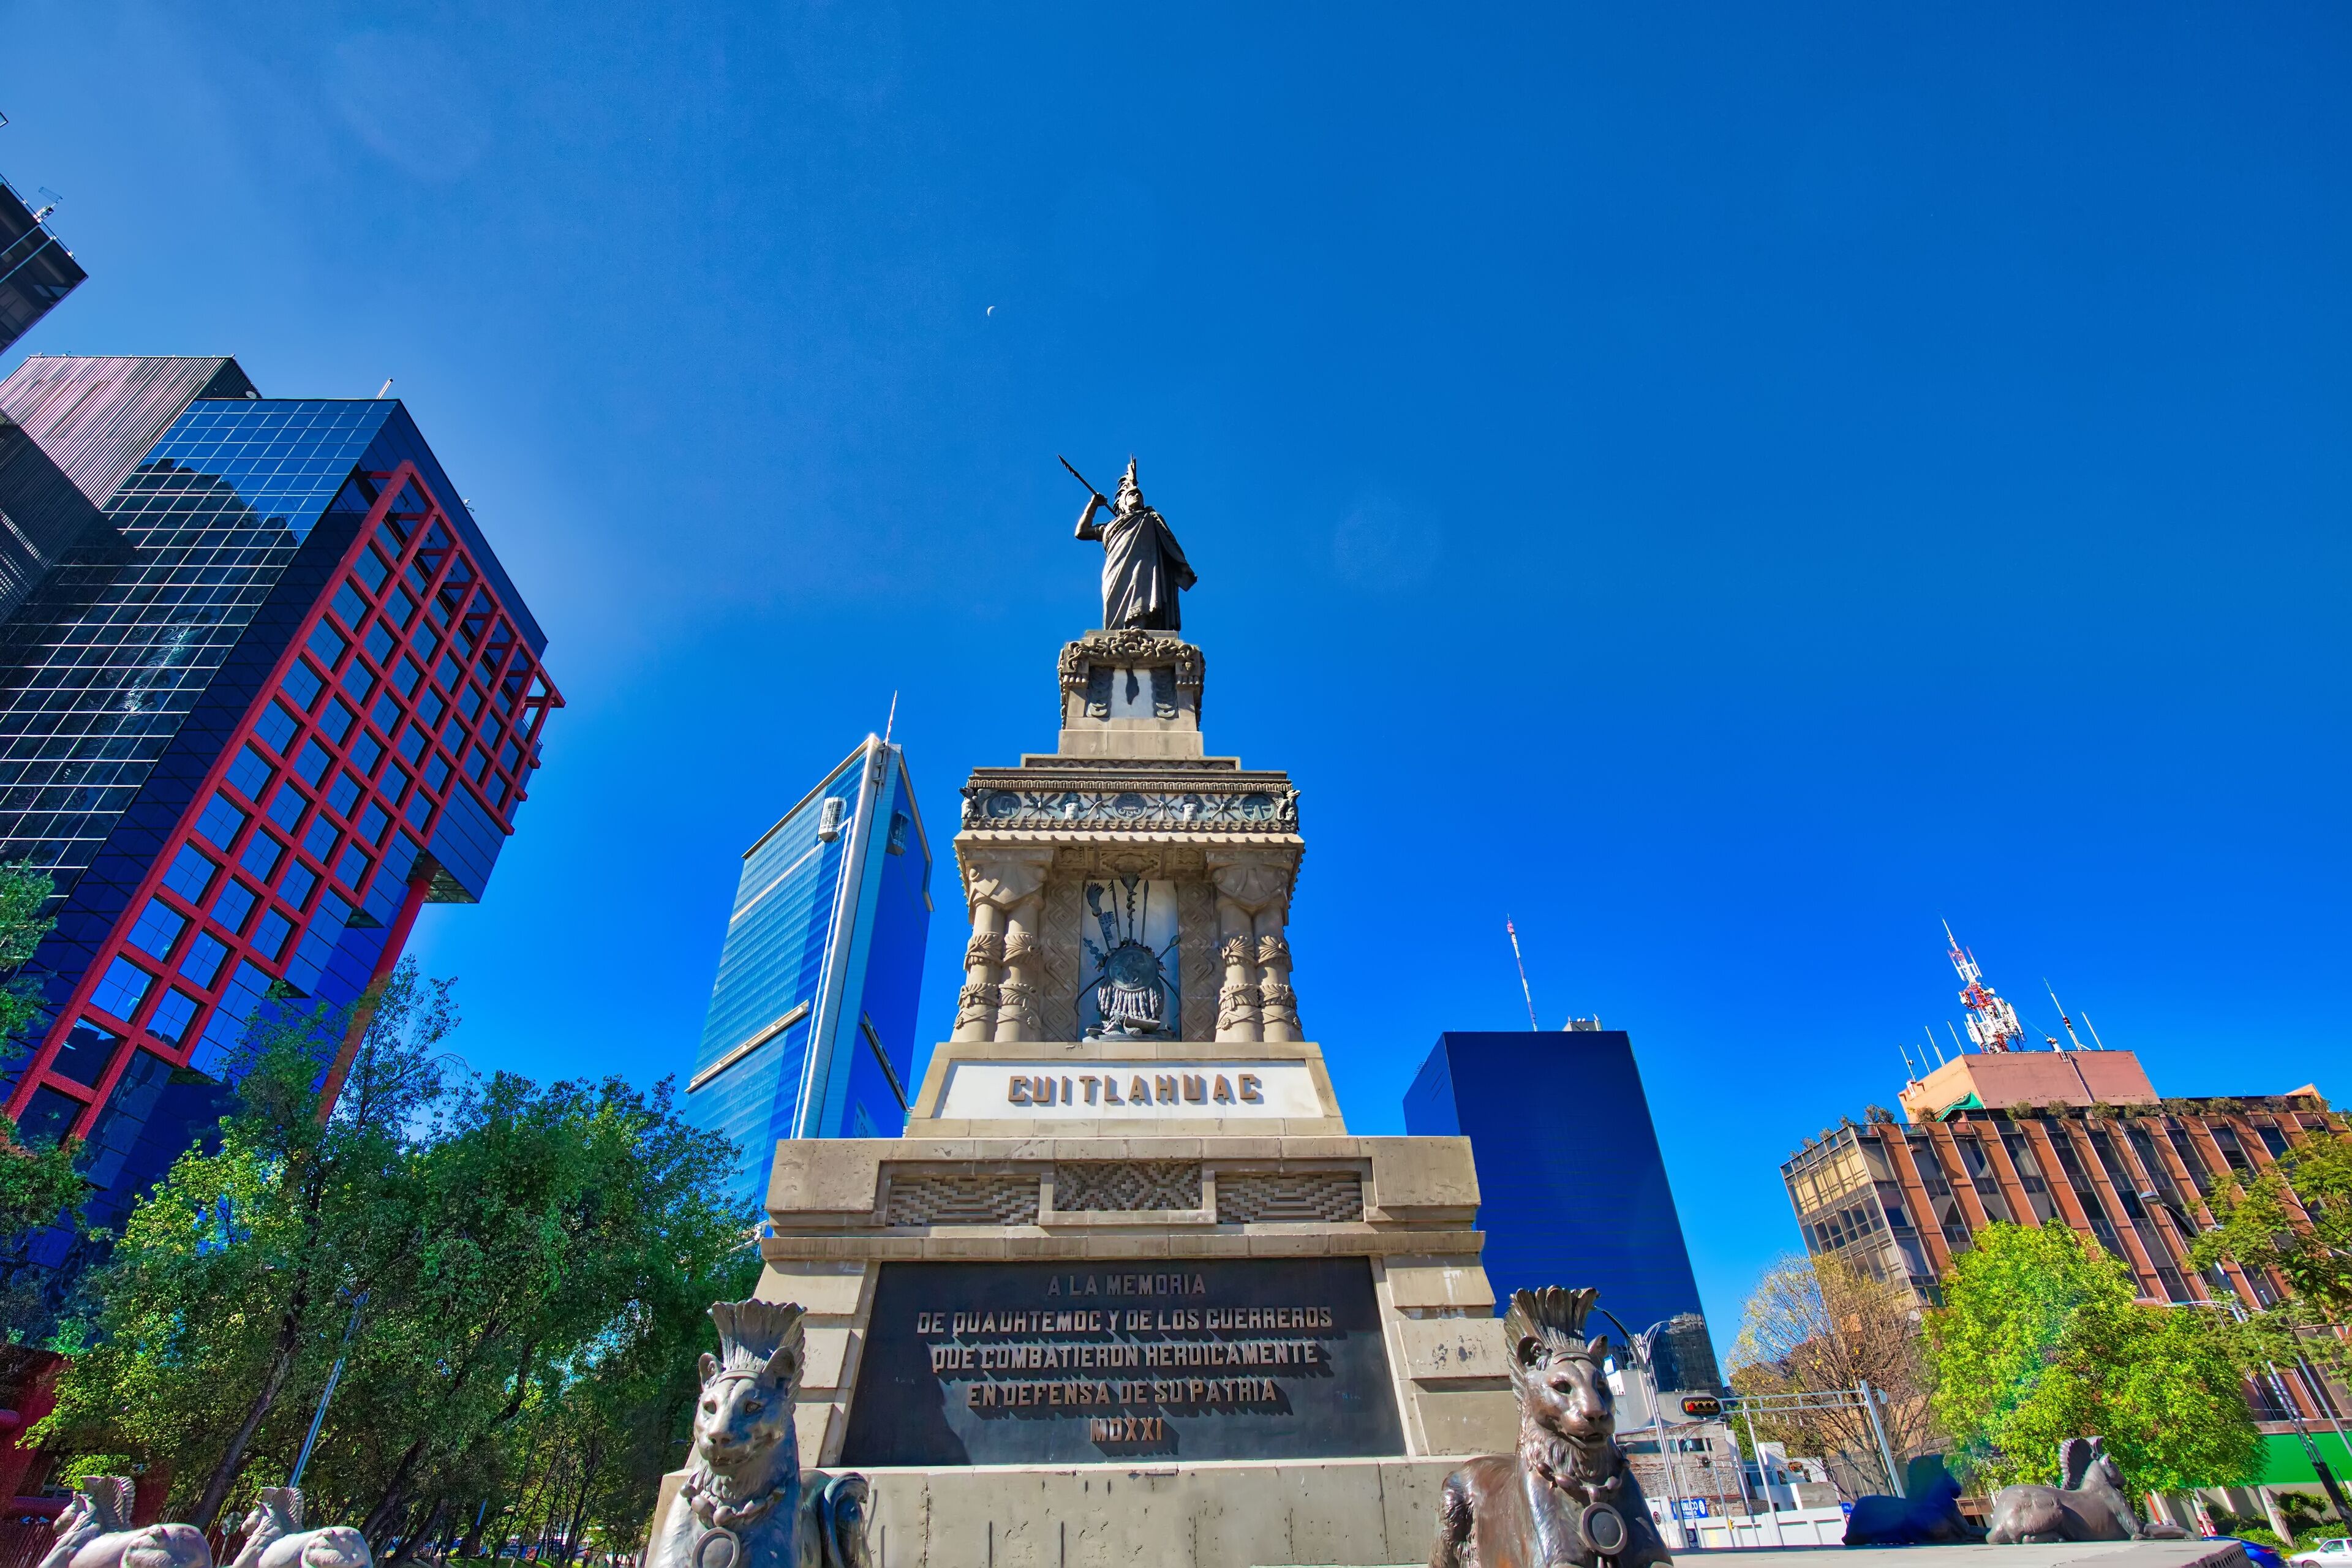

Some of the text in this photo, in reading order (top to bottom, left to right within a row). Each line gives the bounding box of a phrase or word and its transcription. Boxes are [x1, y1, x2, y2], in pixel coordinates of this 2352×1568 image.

[1008, 1073, 1257, 1102] CUITLAHUAC
[1047, 1273, 1206, 1297] A LA MEMORIA
[917, 1306, 1333, 1336] DE QUAUHTEMOC Y DE LOS GUERREROS
[932, 1341, 1319, 1373] QUE COMBATIERON HEROICAMENTE
[967, 1378, 1277, 1406] EN DEFENSA DE SU PATRIA
[1090, 1417, 1162, 1442] MDXXI
